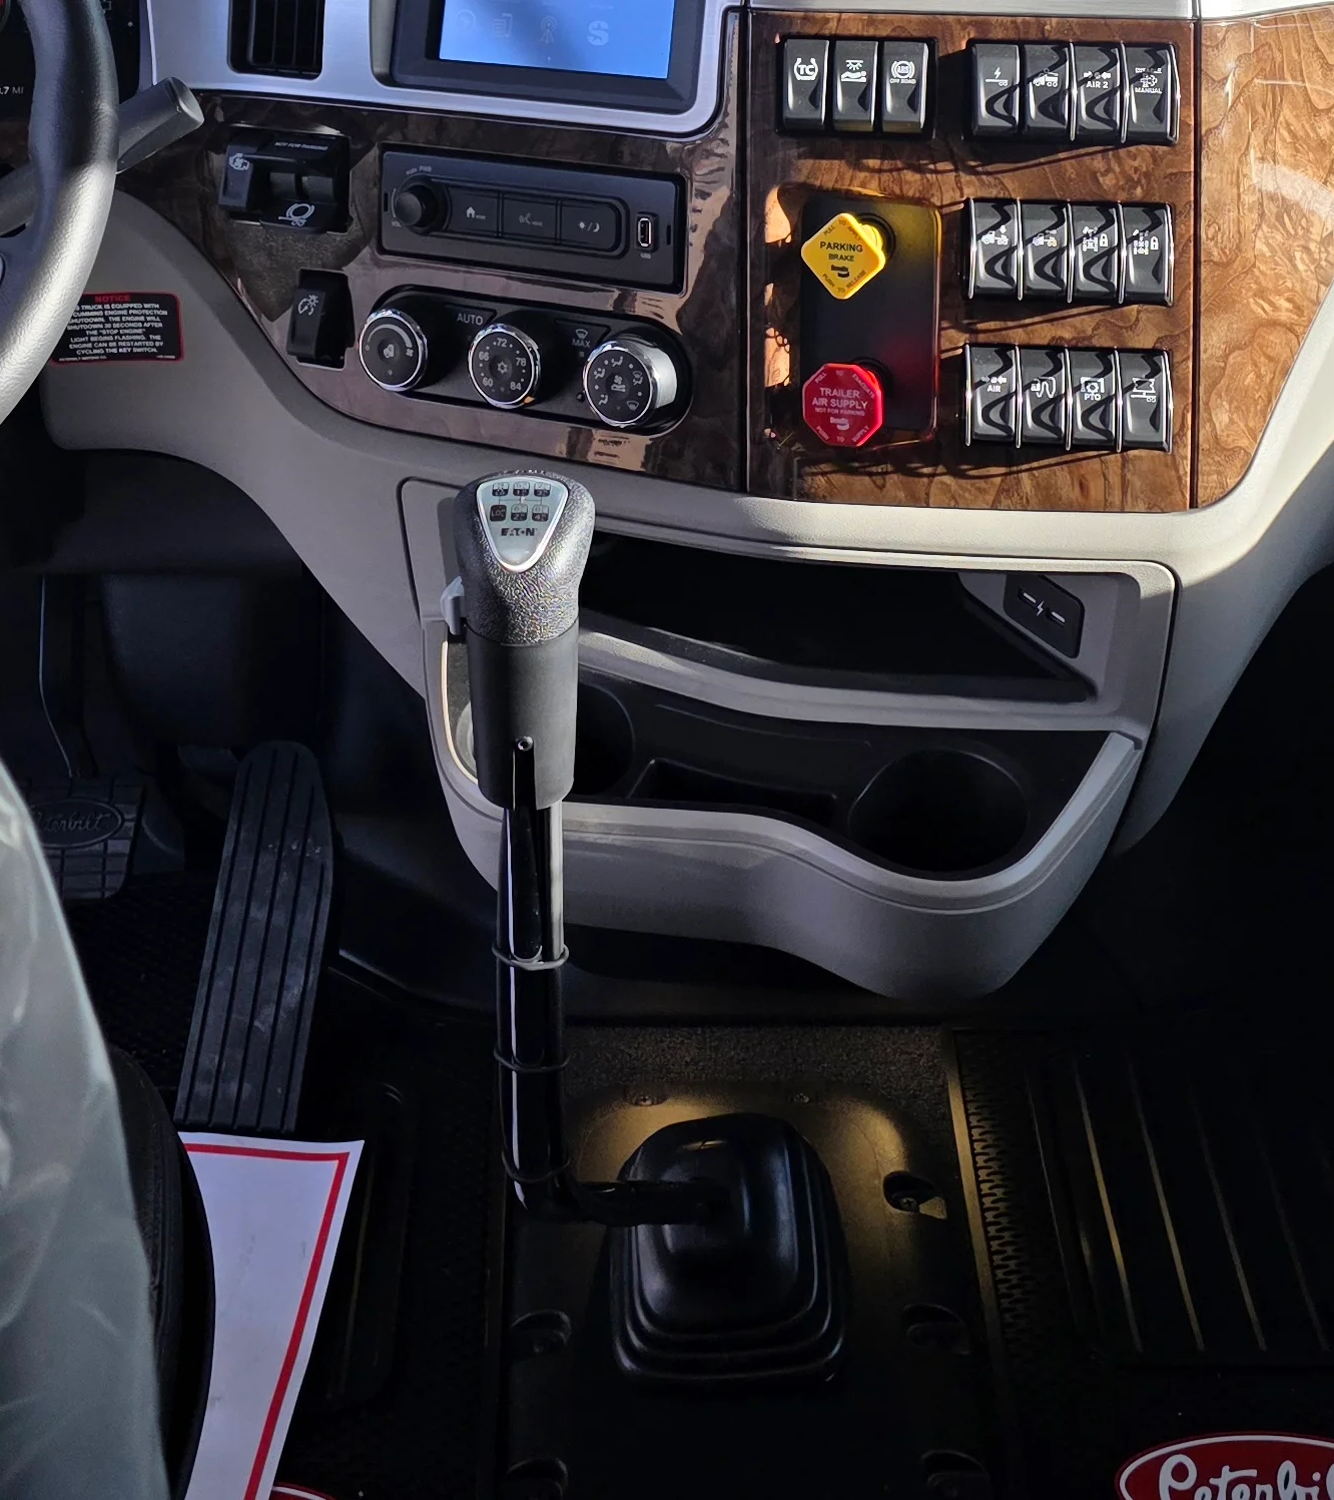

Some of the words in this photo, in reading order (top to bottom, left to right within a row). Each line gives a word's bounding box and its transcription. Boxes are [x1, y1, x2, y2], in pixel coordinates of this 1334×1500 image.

[798, 64, 815, 75] TC
[1086, 80, 1102, 89] AIR
[1103, 80, 1109, 89] 2
[11, 86, 24, 95] MI
[819, 241, 864, 253] PARKING
[828, 253, 855, 262] BRAKE
[94, 295, 131, 303] NOTICE
[456, 312, 484, 326] AUTO
[67, 323, 103, 331] SHUTDOWN
[497, 338, 508, 348] 72
[572, 338, 591, 349] MAX
[478, 351, 490, 361] 66
[516, 357, 527, 367] 78
[482, 377, 494, 388] 60
[509, 381, 522, 391] 84
[819, 387, 860, 398] TRAILER
[987, 385, 1001, 393] AIR
[1084, 393, 1102, 401] PTO
[812, 397, 828, 406] AIR
[829, 399, 868, 410] SUPPLY
